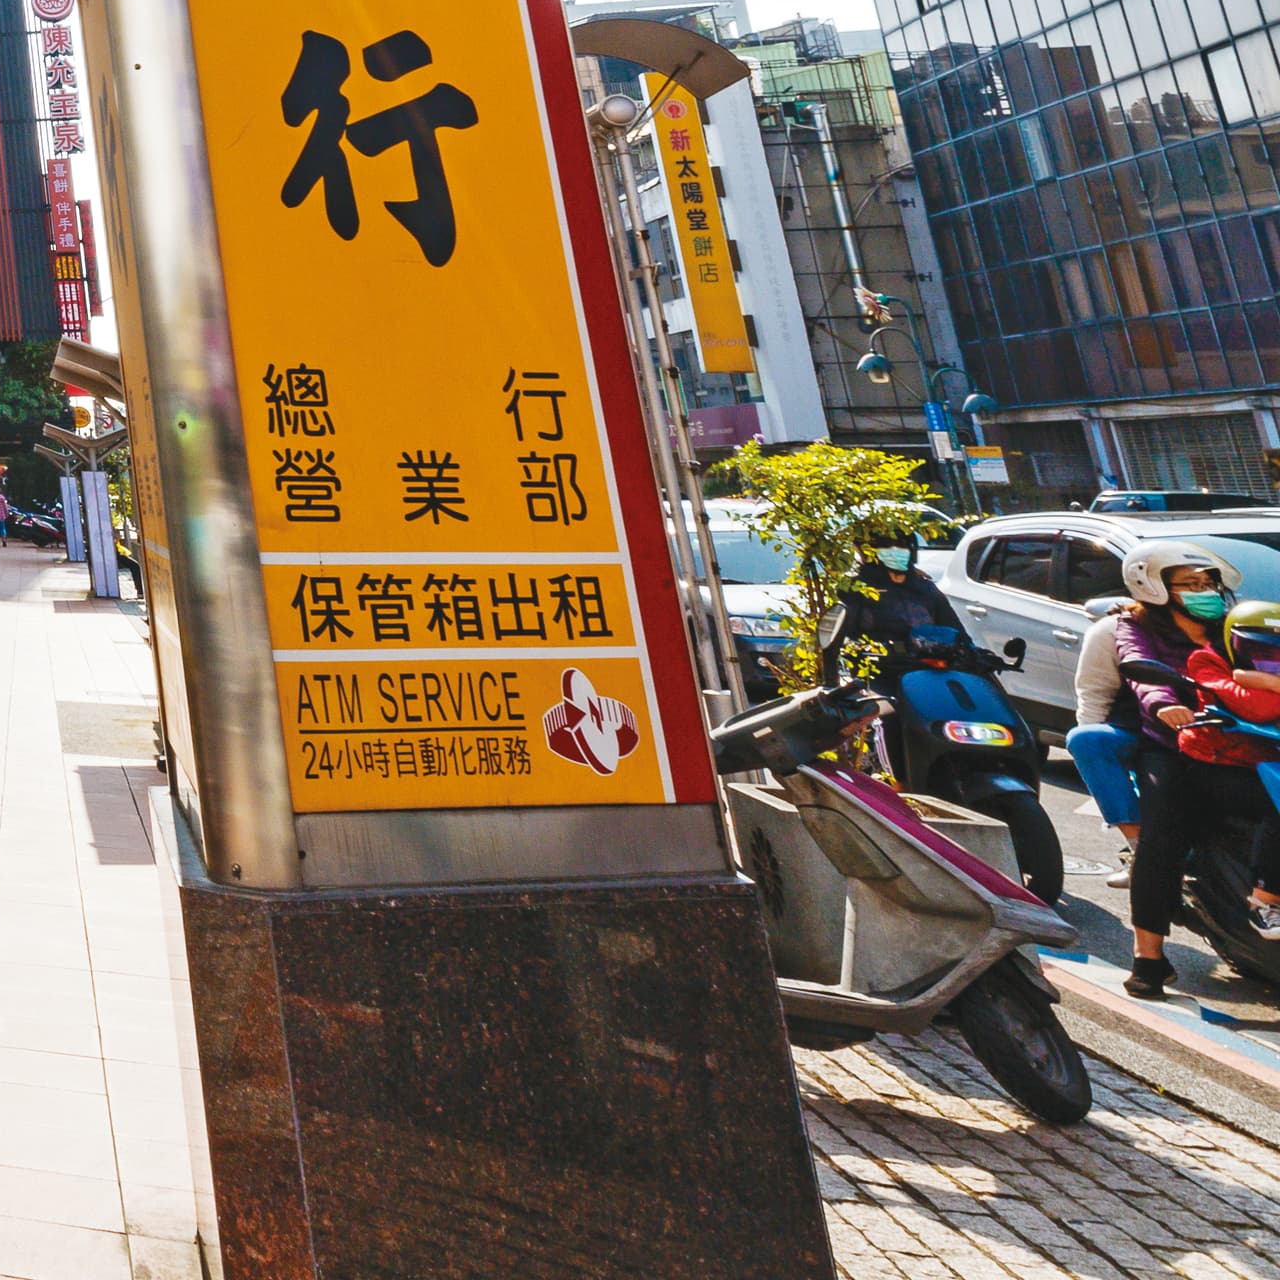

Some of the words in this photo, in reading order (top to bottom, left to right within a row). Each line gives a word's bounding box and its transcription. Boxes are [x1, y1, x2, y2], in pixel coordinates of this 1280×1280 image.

[42, 25, 85, 153] 陳允宝泉
[272, 448, 587, 526] 營業部
[291, 572, 614, 643] 保管箱出租
[297, 673, 363, 724] ATM
[379, 671, 525, 723] SERVICE
[301, 735, 532, 780] 24小時自動化服務
